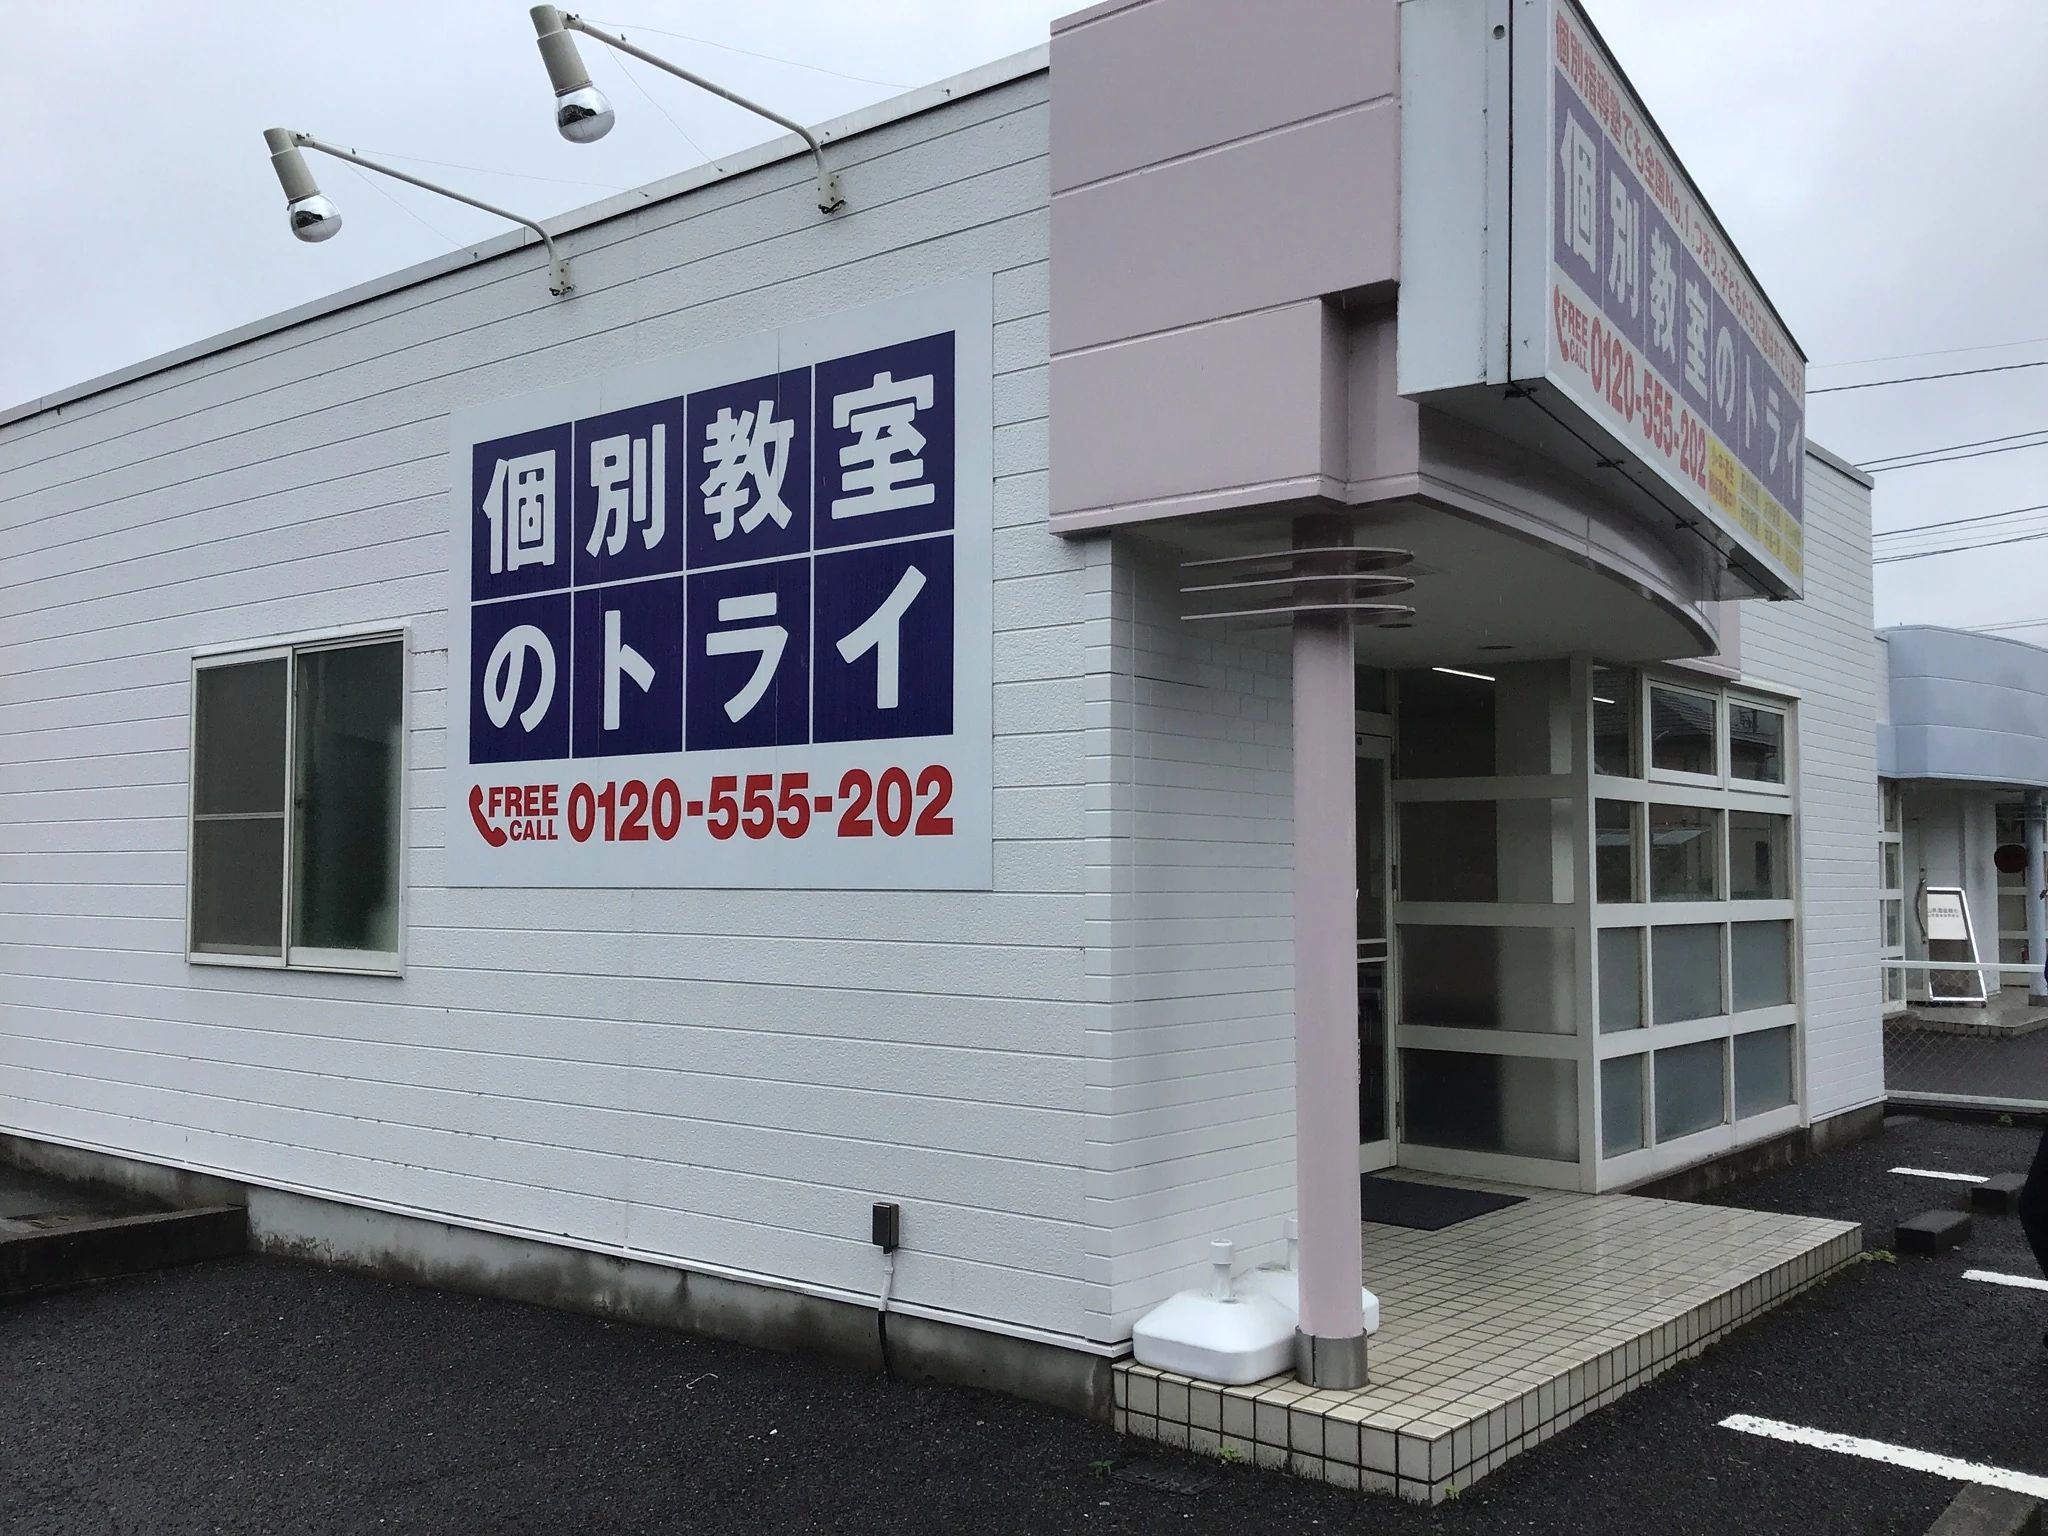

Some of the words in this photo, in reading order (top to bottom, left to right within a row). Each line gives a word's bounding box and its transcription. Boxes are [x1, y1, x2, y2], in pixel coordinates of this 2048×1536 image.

[1560, 106, 1800, 500] 個別教室のトライ
[1562, 293, 1588, 349] FREE
[1569, 337, 1588, 374] CALL
[1590, 315, 1706, 490] 0120-555-202
[482, 371, 935, 574] 個別教室
[482, 564, 927, 733] のトライ
[488, 784, 559, 818] FREE
[508, 819, 559, 842] CALL
[567, 765, 954, 843] 0120-555-202
